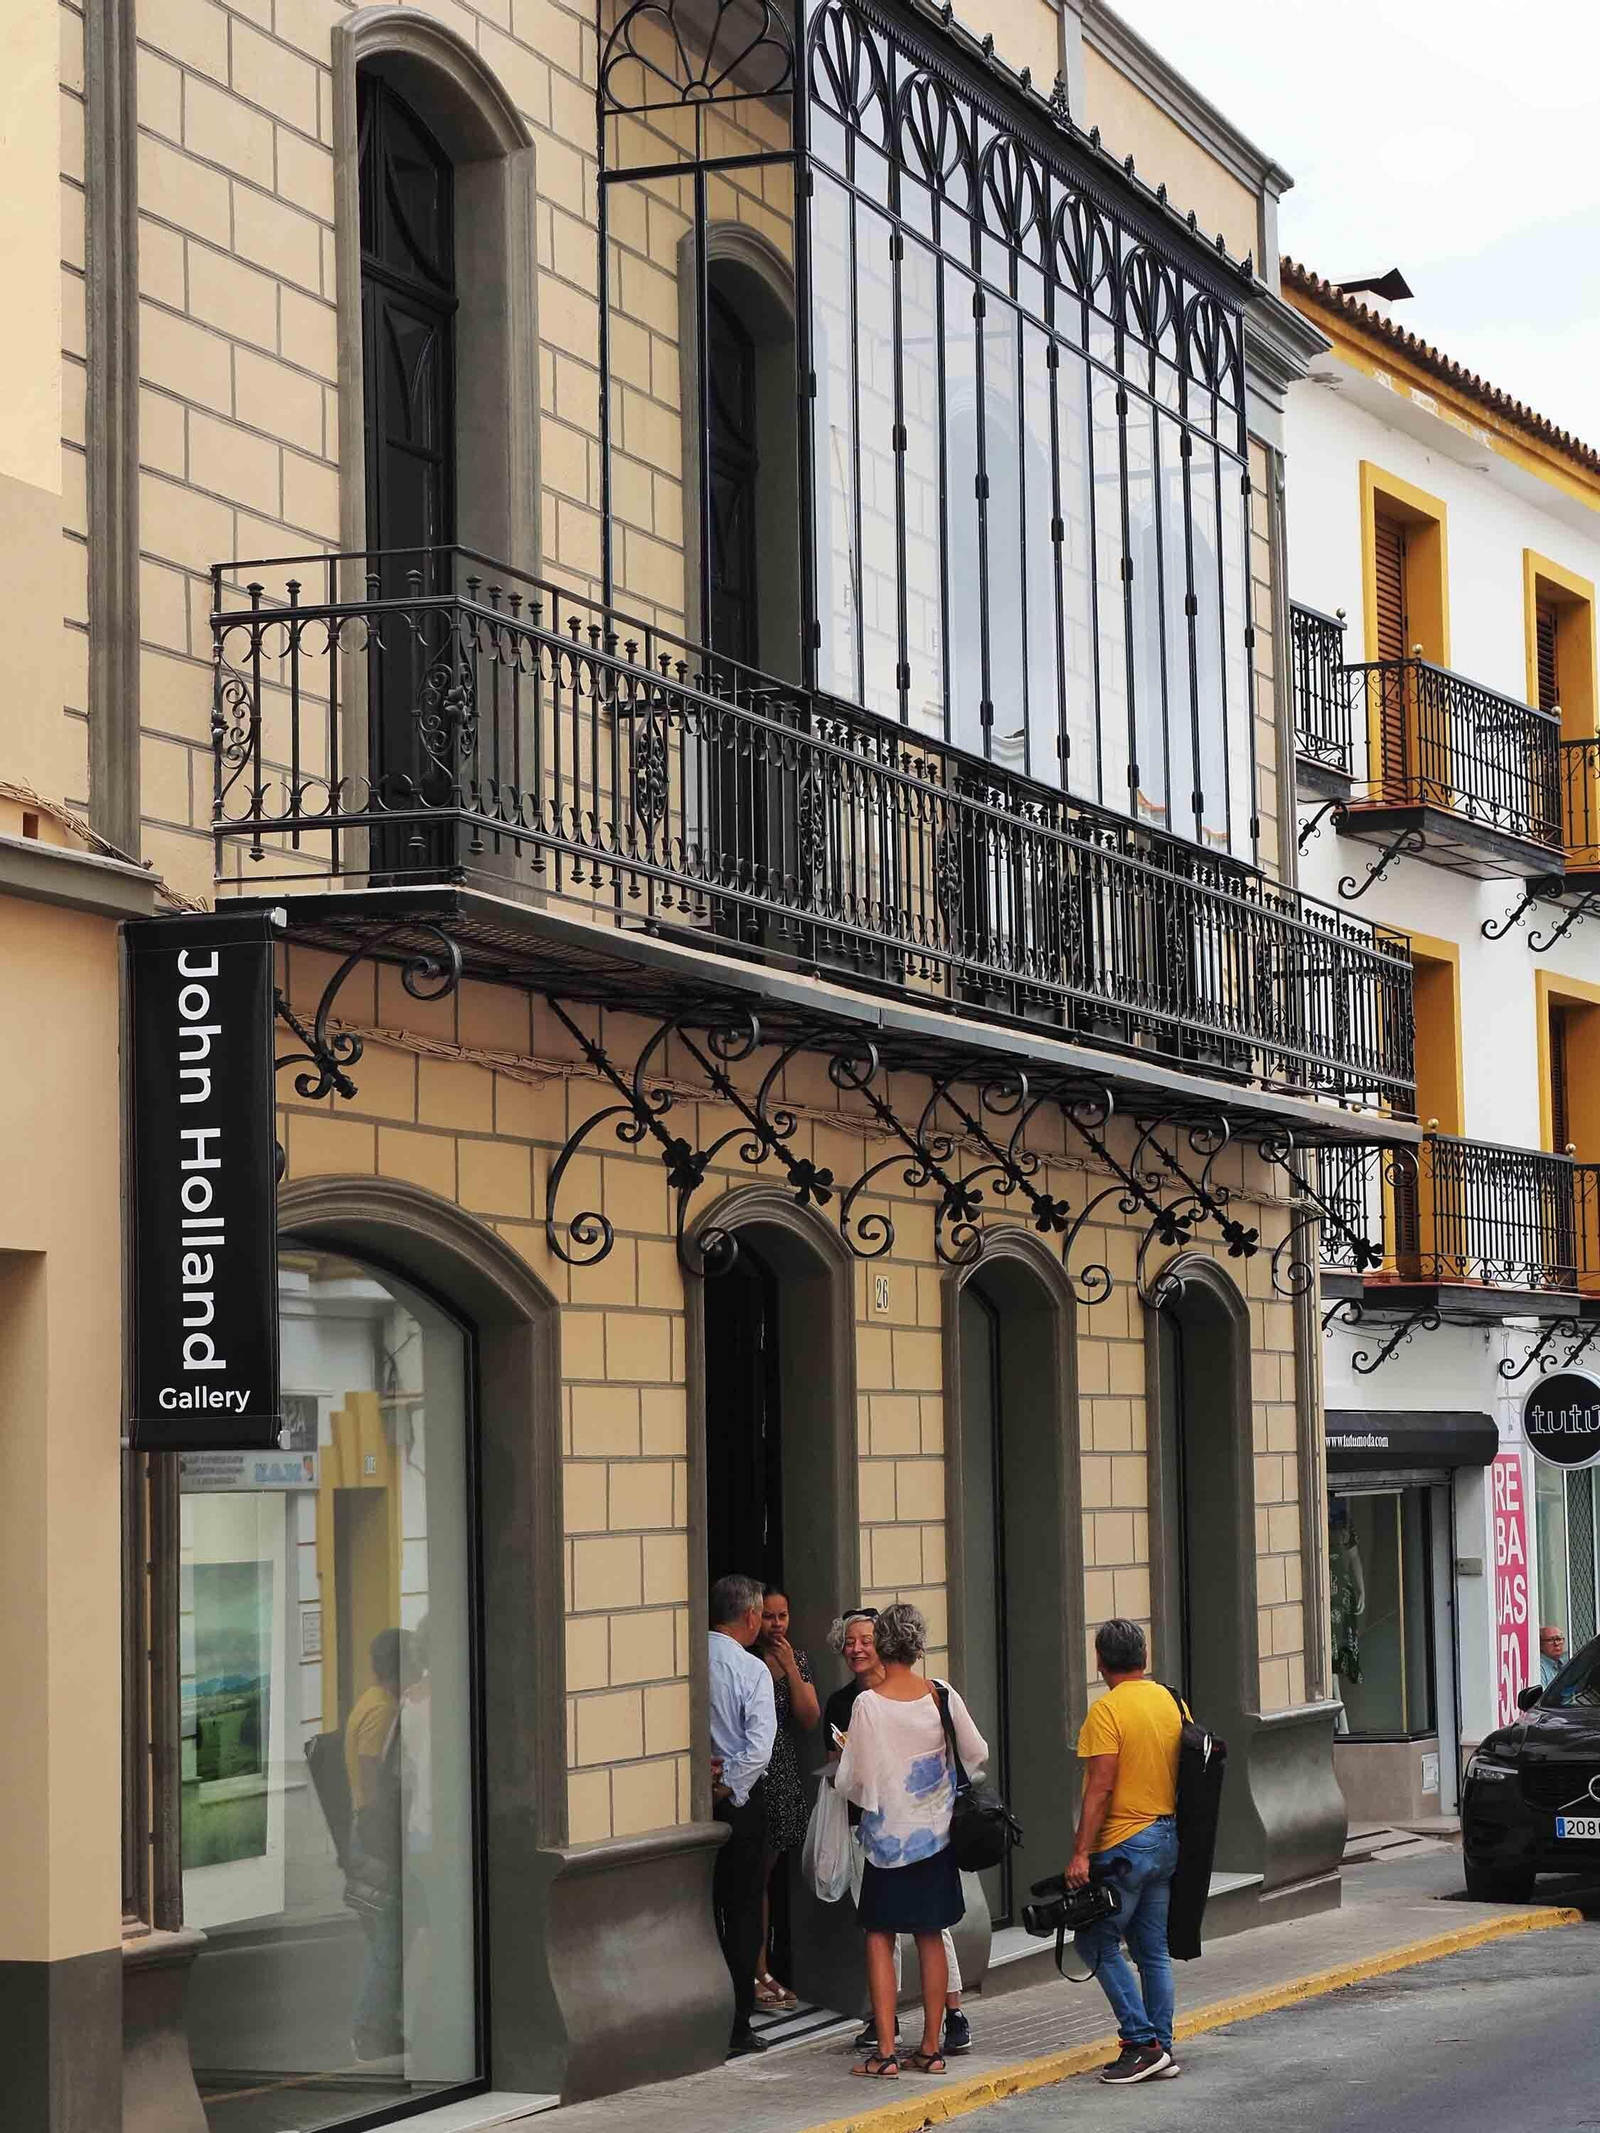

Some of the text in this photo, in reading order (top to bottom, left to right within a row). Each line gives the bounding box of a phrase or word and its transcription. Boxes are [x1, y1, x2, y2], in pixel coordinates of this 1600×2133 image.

[177, 949, 227, 1370] John Holland
[876, 1278, 889, 1309] 26
[158, 1385, 251, 1413] Gallery
[1566, 1820, 1600, 1836] 208
